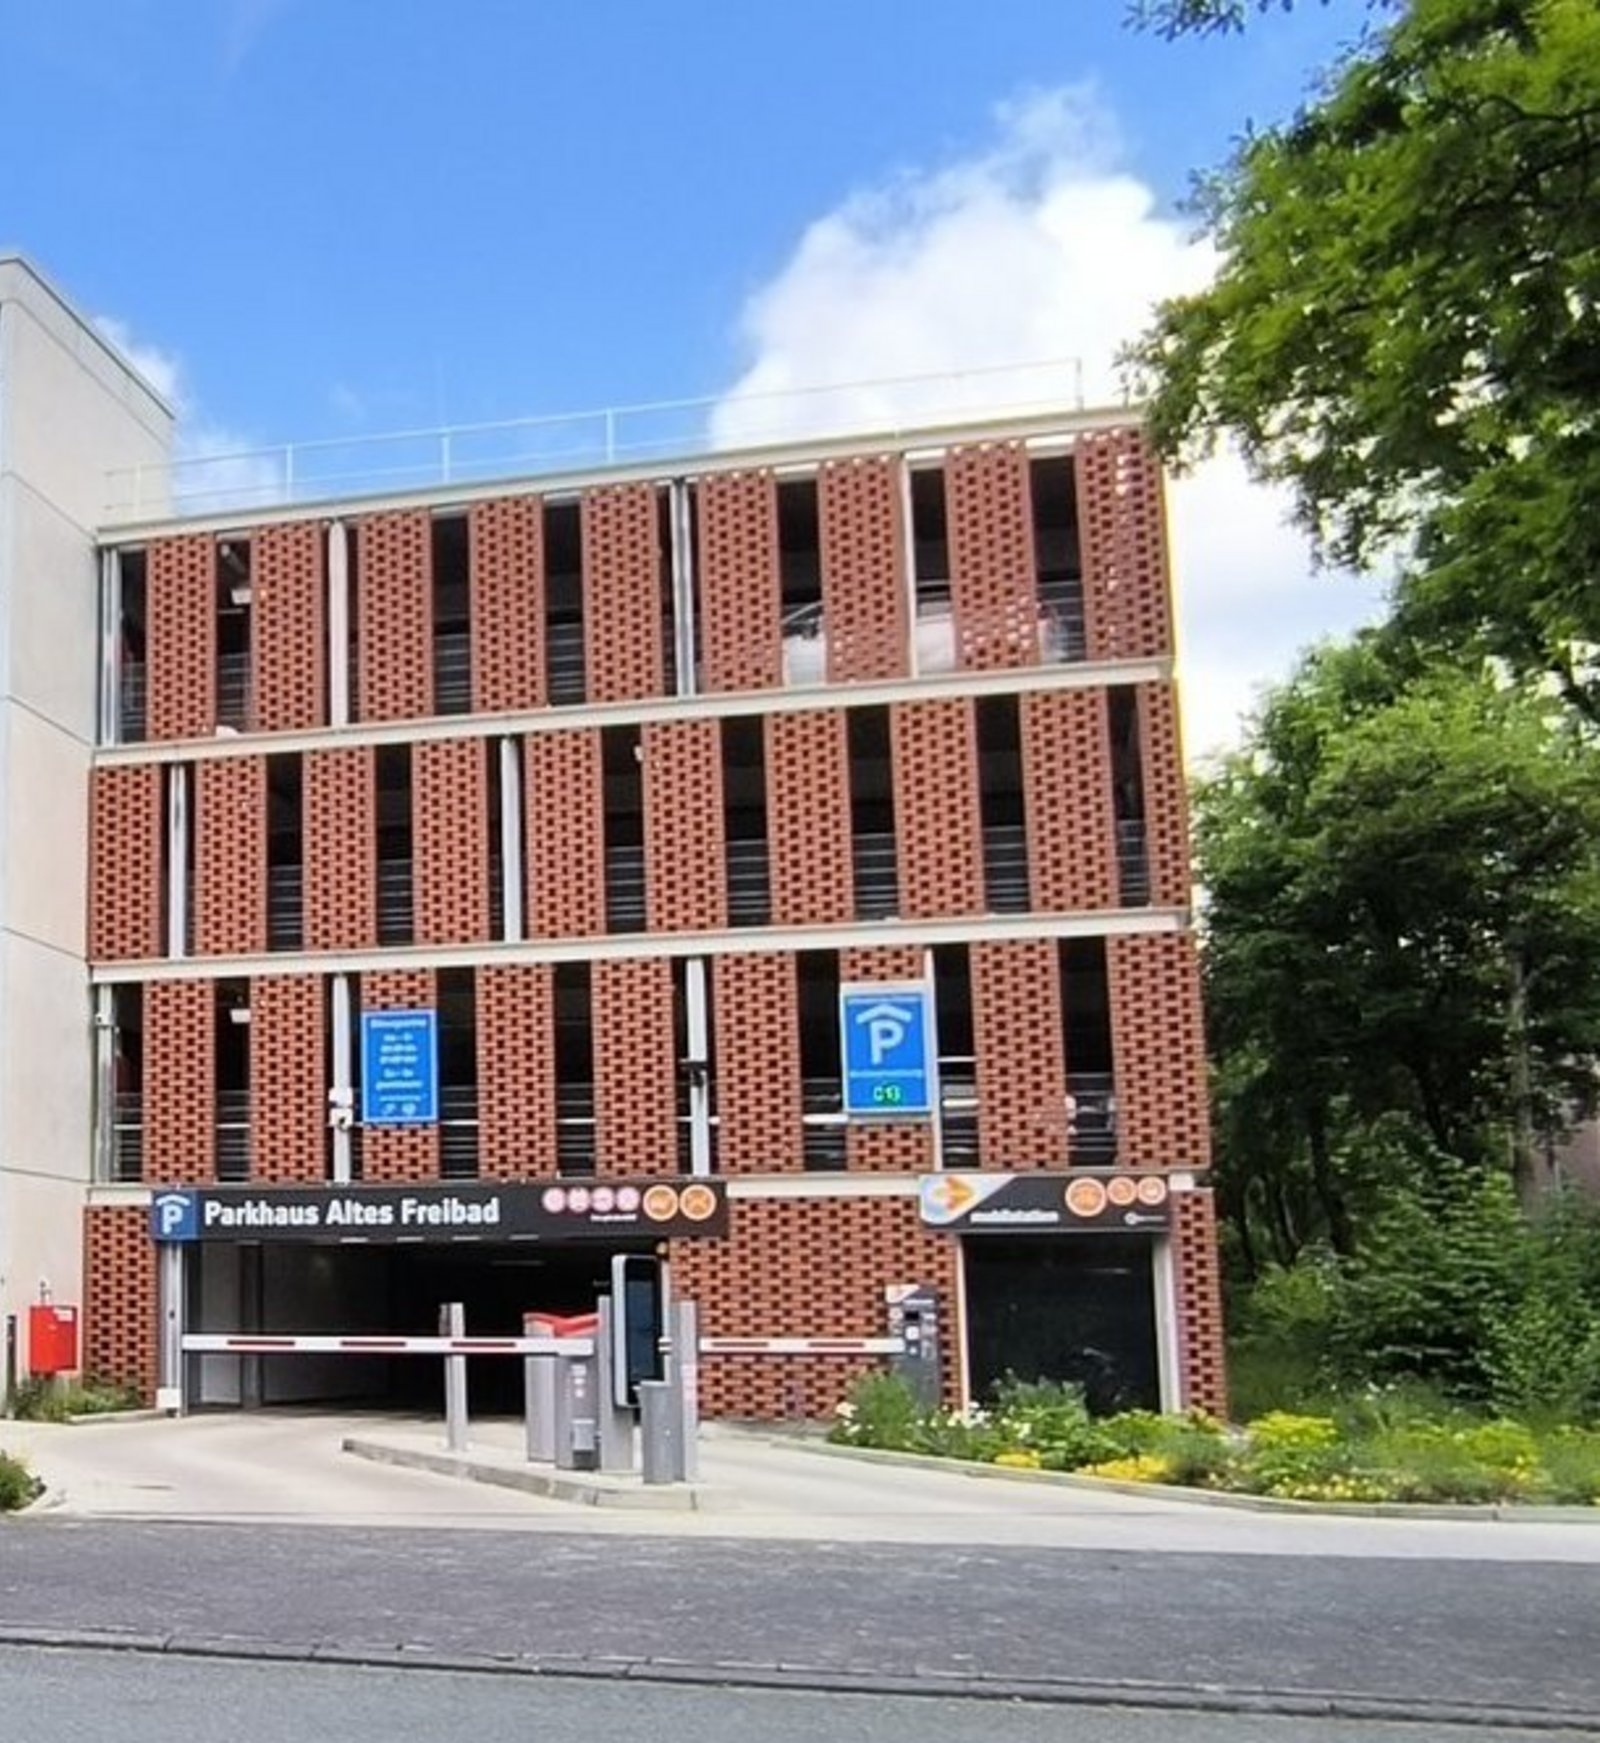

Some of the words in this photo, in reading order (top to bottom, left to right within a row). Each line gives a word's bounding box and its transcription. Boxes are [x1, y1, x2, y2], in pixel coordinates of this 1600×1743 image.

[870, 1019, 904, 1065] P
[161, 1204, 183, 1235] P
[205, 1200, 319, 1226] Parkhaus
[325, 1199, 394, 1225] Altes
[401, 1197, 500, 1225] Freibad
